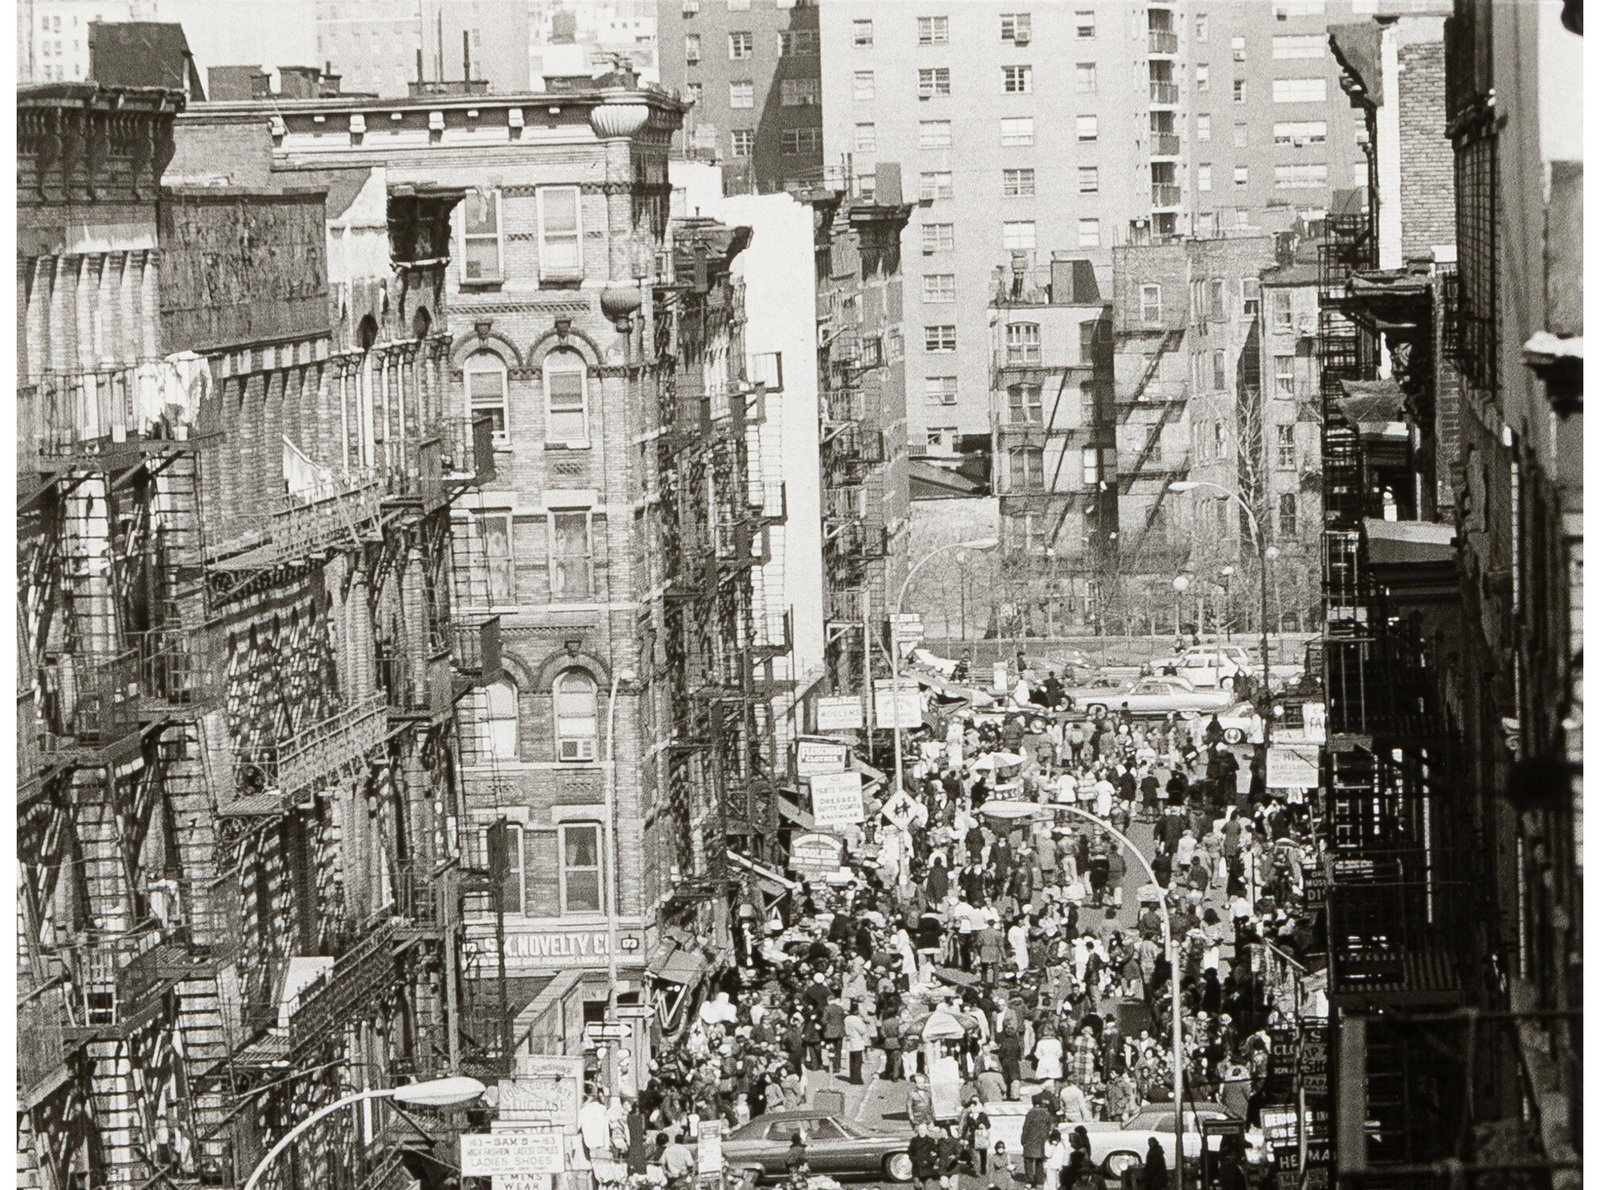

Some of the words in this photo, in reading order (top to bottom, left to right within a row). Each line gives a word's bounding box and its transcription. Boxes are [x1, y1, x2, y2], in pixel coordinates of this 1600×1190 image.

[523, 933, 590, 956] NOVELTY
[514, 1155, 553, 1166] SHOES
[503, 1183, 540, 1190] WEAR
